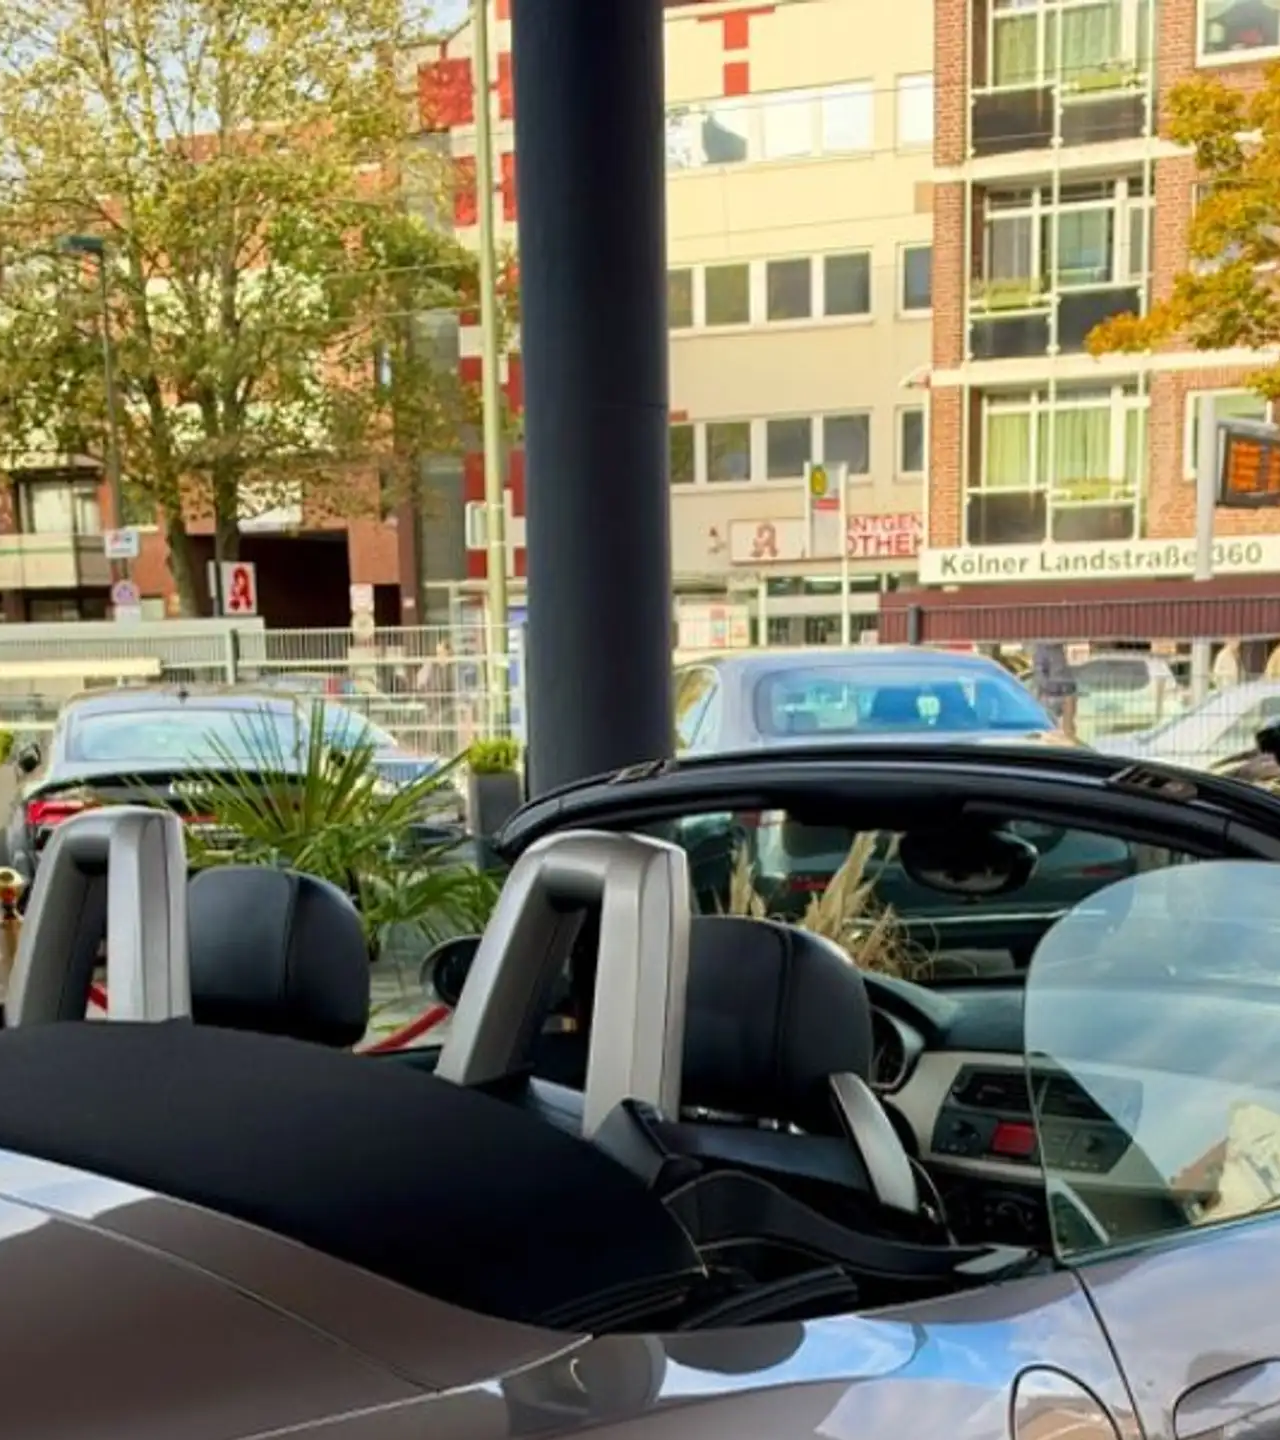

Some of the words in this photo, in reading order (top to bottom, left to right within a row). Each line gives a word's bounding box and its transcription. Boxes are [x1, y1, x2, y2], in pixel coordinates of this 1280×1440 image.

[941, 552, 1030, 576] Kölner
[1040, 544, 1197, 572] Landstraße
[1211, 541, 1263, 565] 360
